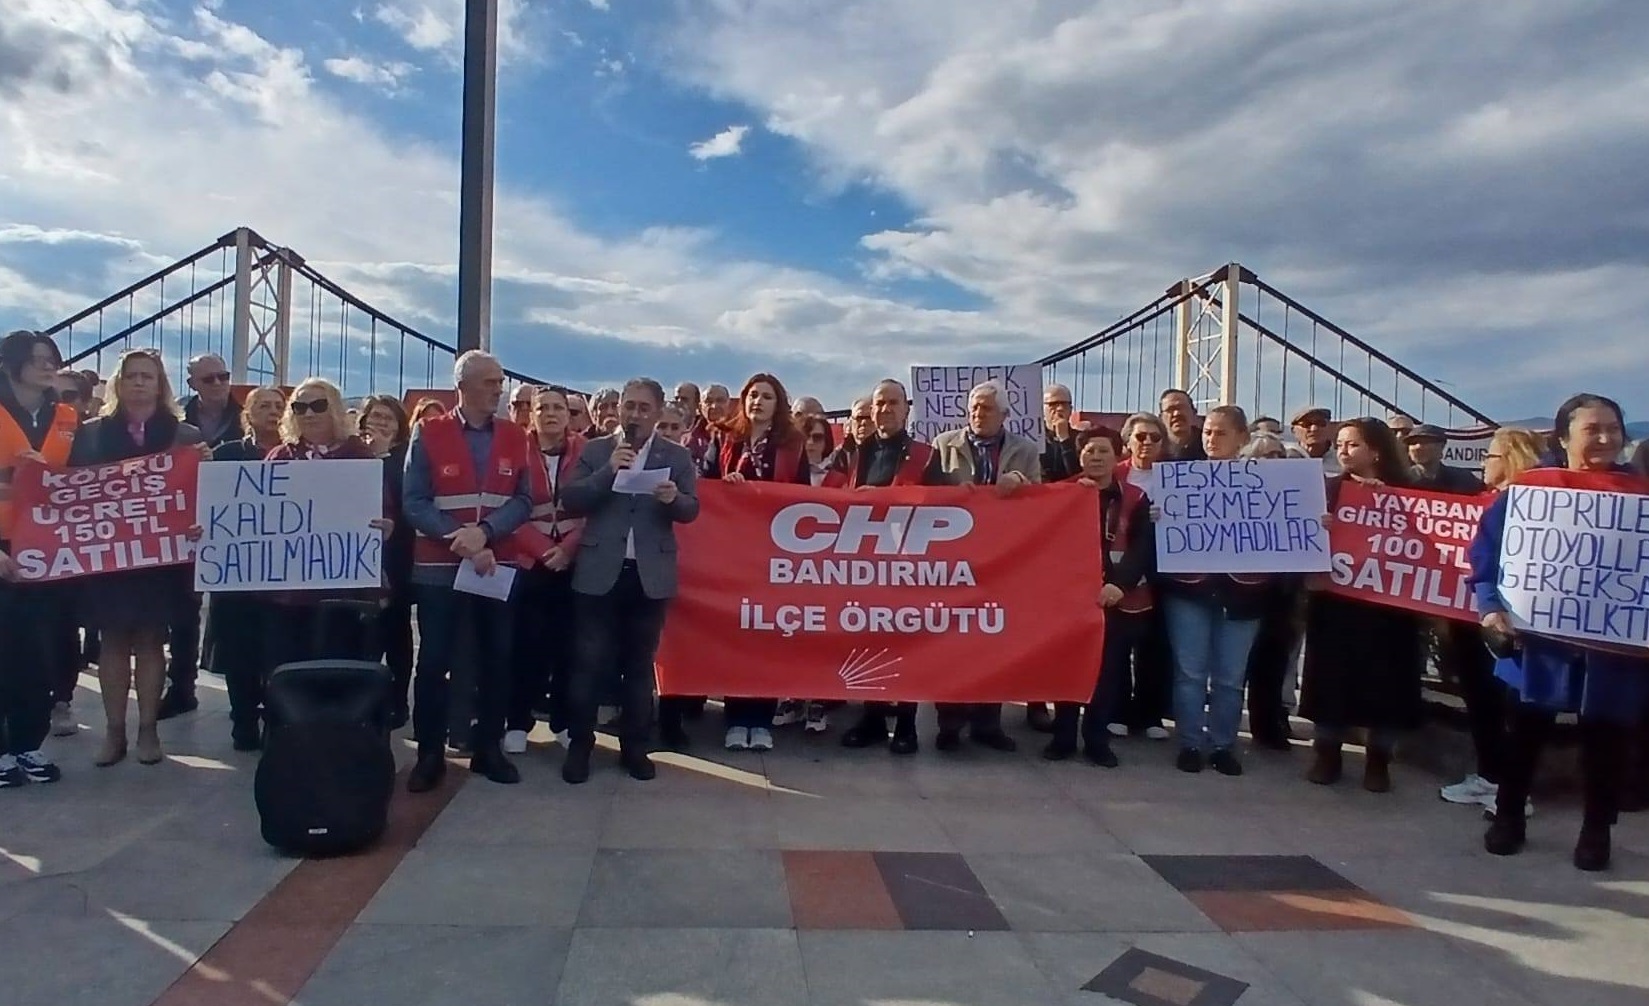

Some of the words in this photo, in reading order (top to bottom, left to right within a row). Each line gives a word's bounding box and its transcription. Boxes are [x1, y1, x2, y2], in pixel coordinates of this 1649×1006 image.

[925, 387, 1028, 417] NESRİ
[42, 453, 174, 488] KÖPRÜ
[234, 461, 290, 498] NE
[50, 474, 167, 504] GEÇİŞ
[1164, 489, 1301, 520] ÇEKMEYE
[33, 490, 186, 525] ÜCRETİ
[209, 499, 313, 541] KALDI
[1338, 505, 1408, 535] GİRİŞ
[54, 520, 116, 543] 150
[125, 515, 169, 535] TL
[770, 503, 975, 556] CHP
[1166, 518, 1323, 554] DOYMADILAR
[200, 532, 381, 585] SATILMADIK?
[1367, 533, 1424, 560] 100
[1434, 542, 1472, 570] TL
[769, 558, 976, 587] BANDIRMA
[739, 597, 826, 637] İLÇE
[839, 601, 1005, 634] ÖRGÜTÜ
